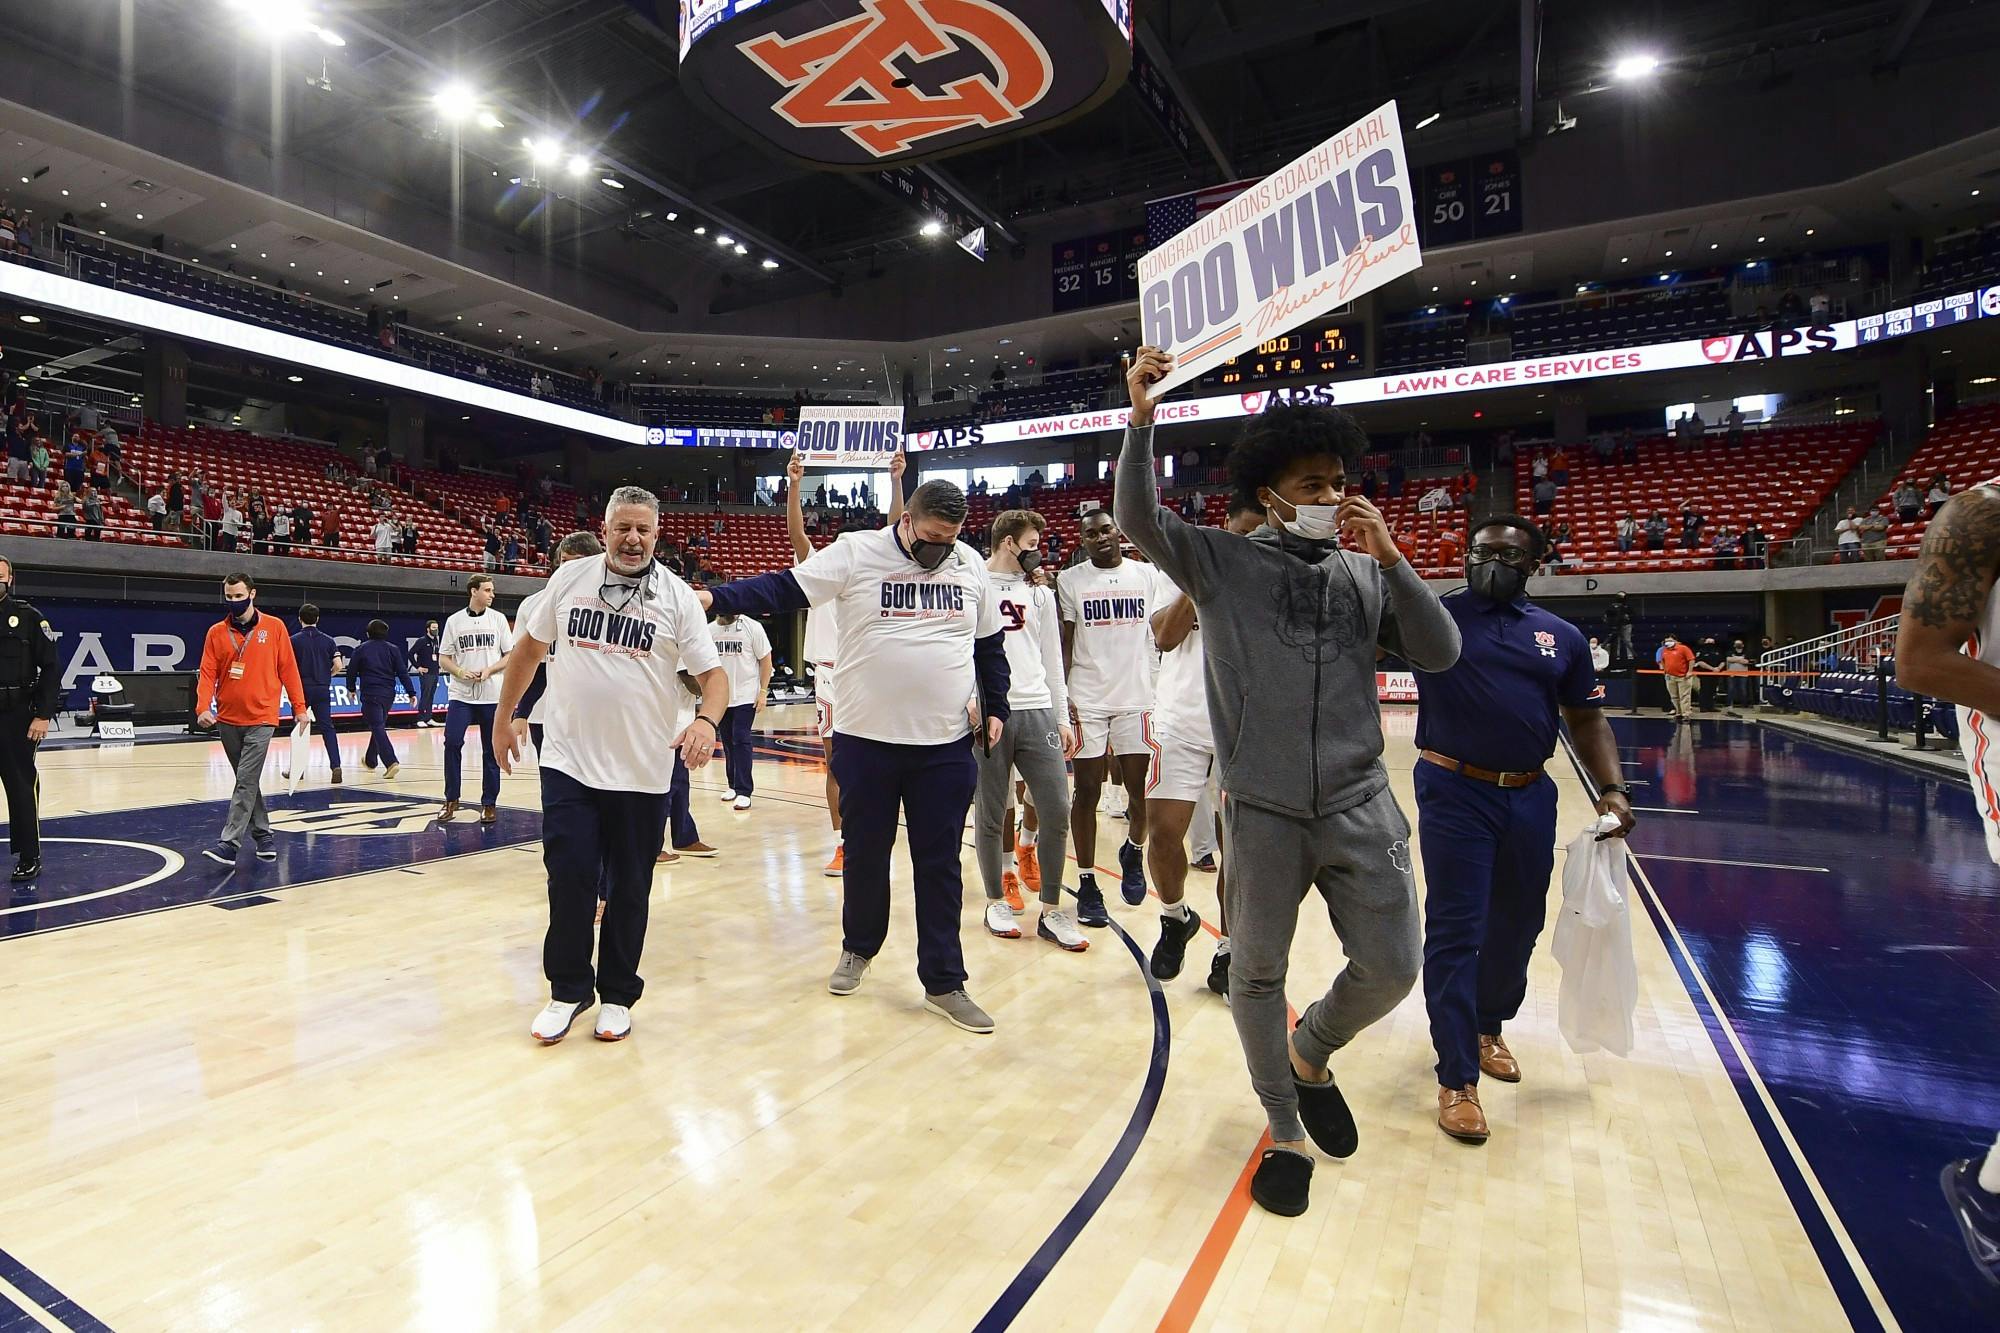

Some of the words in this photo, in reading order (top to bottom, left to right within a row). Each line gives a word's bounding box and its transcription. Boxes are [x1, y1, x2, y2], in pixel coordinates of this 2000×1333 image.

[1141, 184, 1271, 283] CONGRATULATIONS
[1274, 148, 1330, 201] COACH
[1333, 114, 1390, 166] PEARL
[1484, 192, 1511, 215] 21
[1433, 201, 1465, 224] 50
[1143, 241, 1240, 352] 600
[1243, 148, 1404, 303] WINS
[1095, 268, 1113, 286] 15
[1127, 263, 1138, 280] 3
[1058, 274, 1081, 293] 32
[1861, 316, 1882, 328] REB
[1917, 302, 1941, 316] TOV
[1946, 294, 1973, 308] FOULS
[1864, 327, 1879, 342] 40
[1887, 319, 1912, 336] 45.0
[1926, 313, 1935, 328] 9
[1954, 305, 1968, 321] 10
[1383, 375, 1448, 395] LAWN
[1455, 367, 1517, 387] CARE
[1524, 352, 1643, 378] SERVICES
[1734, 325, 1838, 361] APS
[801, 407, 857, 418] CONGRATULATIONS
[859, 407, 880, 418] COACH
[797, 420, 840, 451] 600
[844, 420, 899, 452] WINS
[932, 424, 985, 449] APS
[1018, 419, 1064, 437] LAWN
[1069, 415, 1109, 430] CARE
[1118, 404, 1201, 424] SVICES
[450, 575, 458, 587] H
[1586, 578, 1598, 591] D
[881, 582, 917, 610] 600
[920, 583, 964, 611] WINS
[1083, 599, 1111, 621] 600
[1112, 598, 1145, 619] WINS
[458, 634, 473, 649] 600
[475, 633, 495, 647] WINS
[567, 607, 604, 641] 600
[606, 612, 657, 652] WINS
[725, 641, 742, 653] WINS
[1390, 678, 1416, 689] Alfa
[102, 725, 132, 735] VCOM
